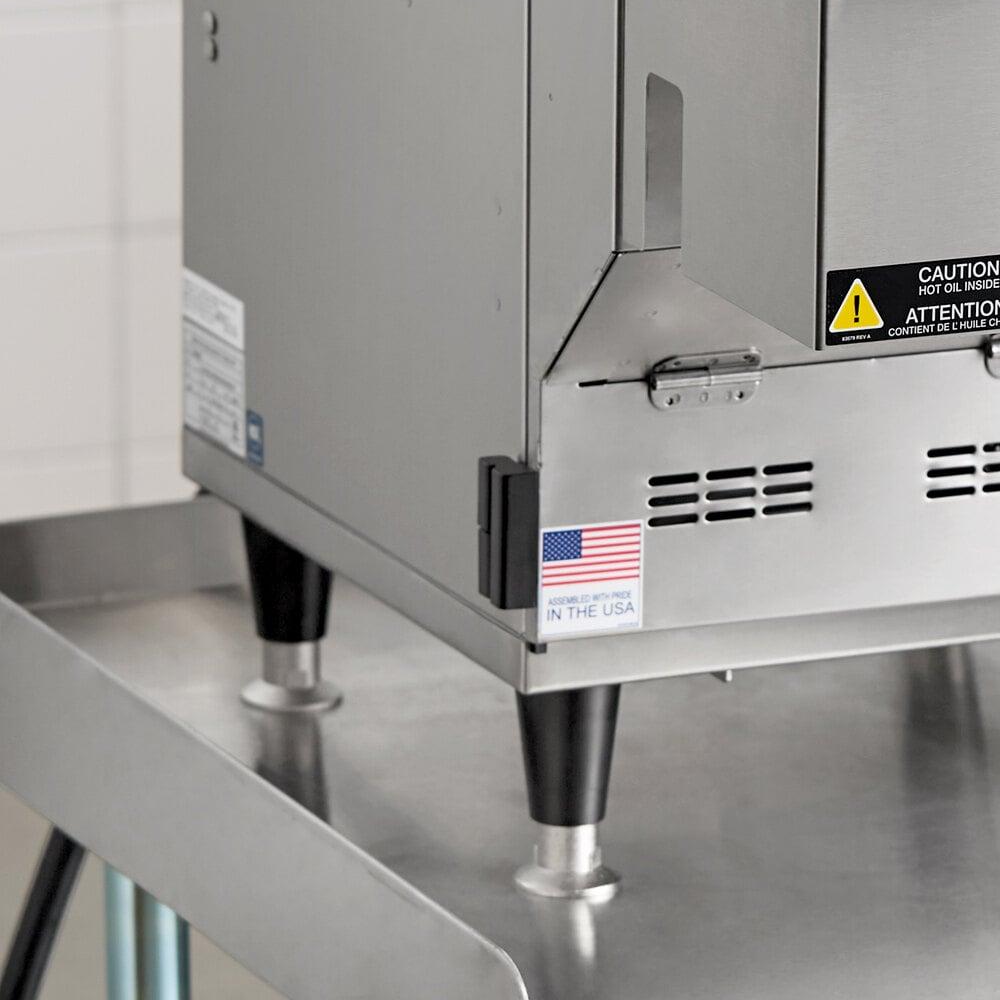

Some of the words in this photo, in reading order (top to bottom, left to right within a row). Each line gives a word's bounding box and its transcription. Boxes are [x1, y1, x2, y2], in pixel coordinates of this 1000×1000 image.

[918, 260, 1000, 283] CAUTION
[918, 283, 941, 296] HOT
[944, 281, 962, 293] OIL
[964, 278, 1000, 291] INSIDE
[888, 324, 935, 337] CONTIENT
[937, 322, 950, 332] DE
[546, 608, 562, 621] IN
[567, 604, 597, 619] THE
[603, 601, 635, 616] USA
